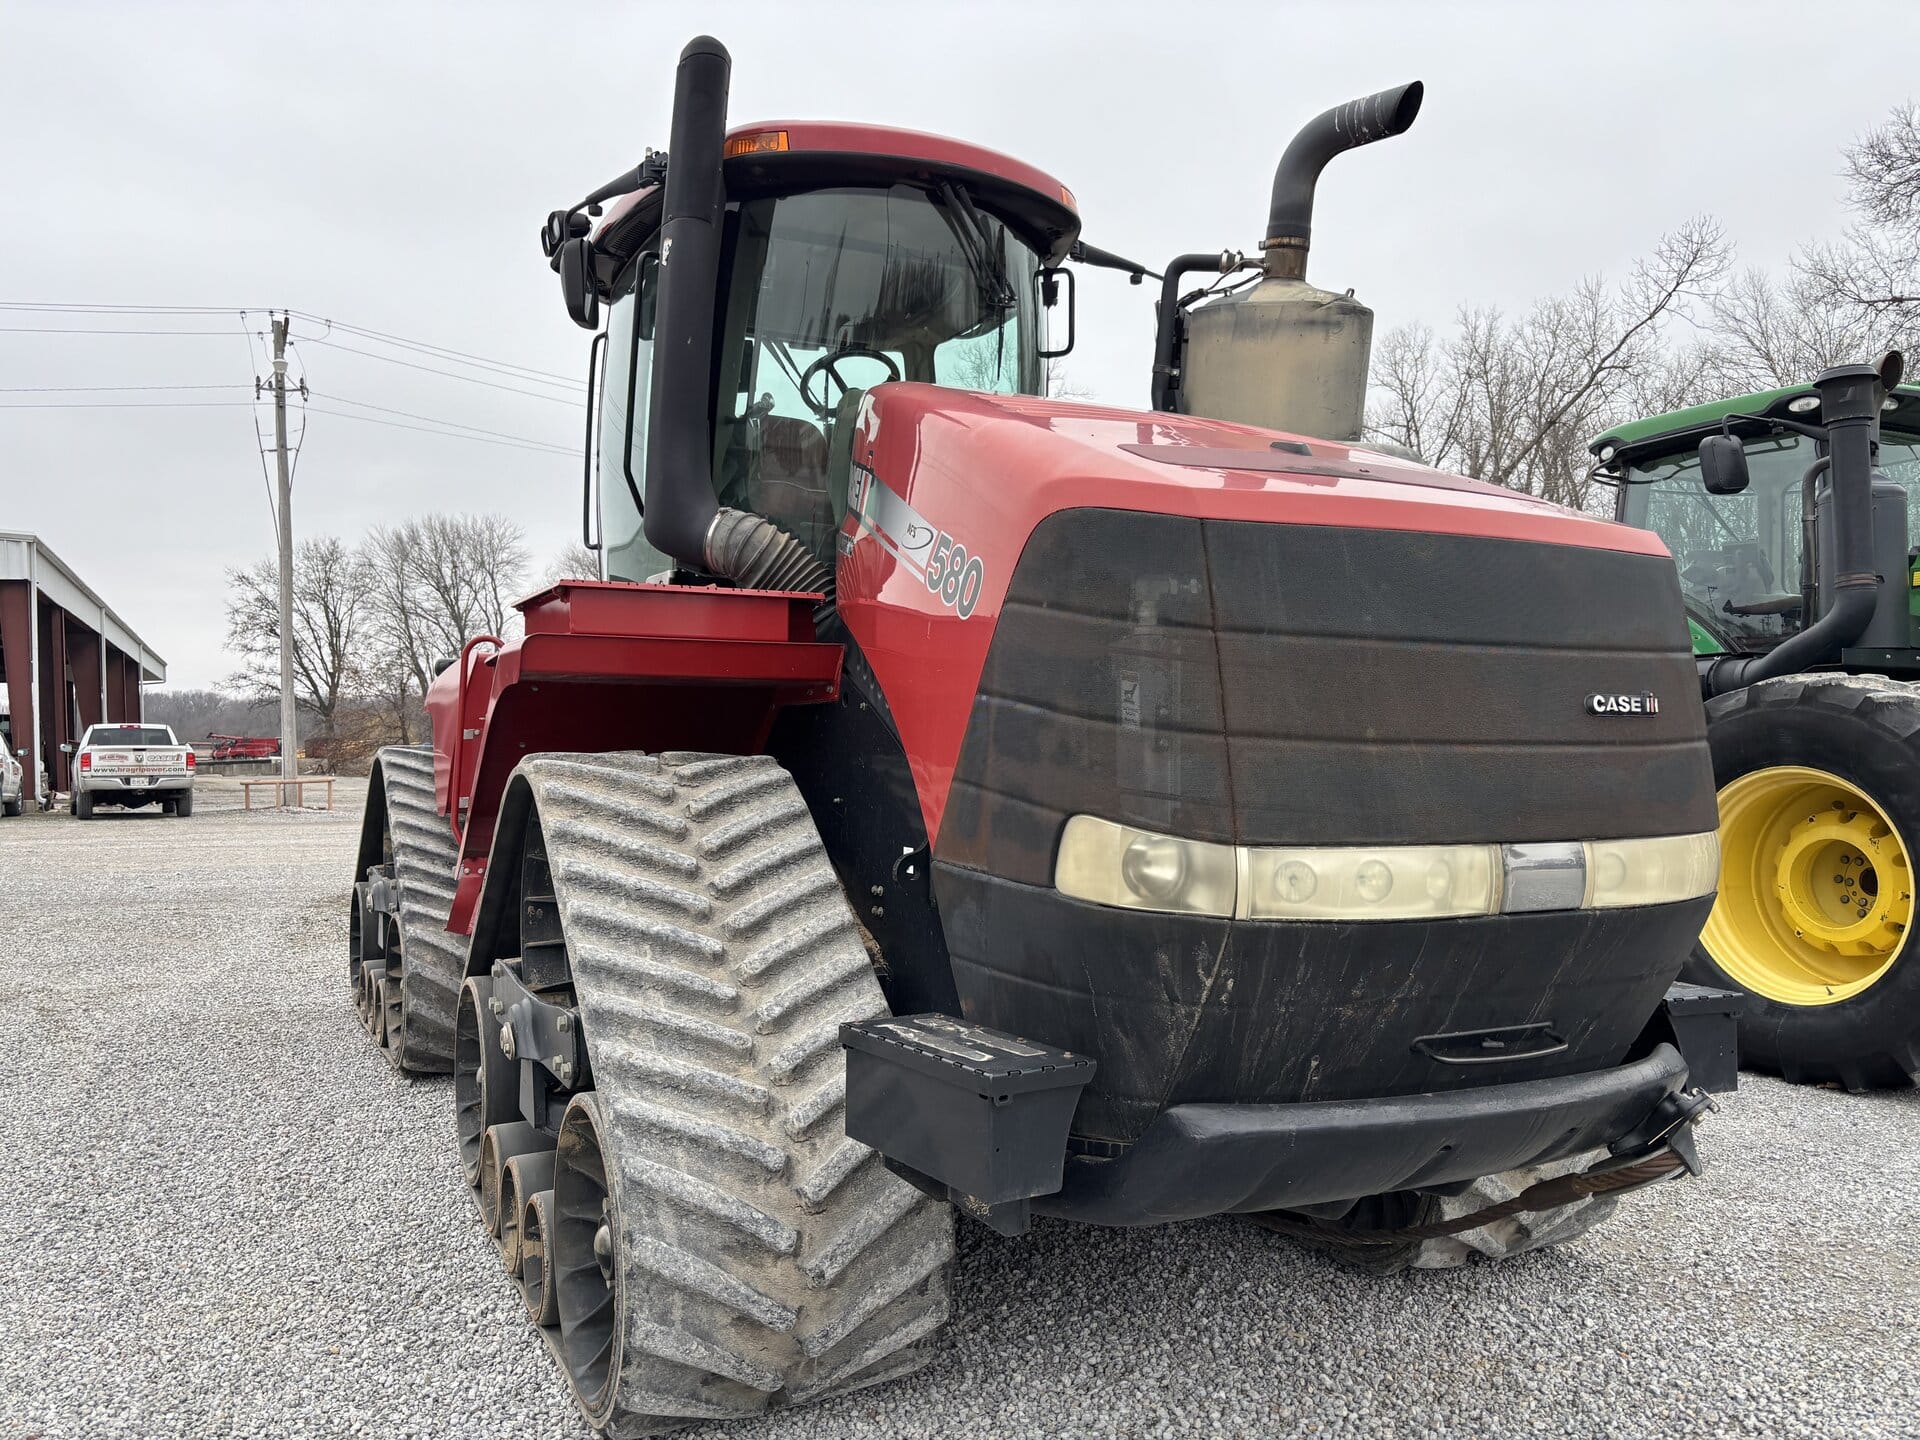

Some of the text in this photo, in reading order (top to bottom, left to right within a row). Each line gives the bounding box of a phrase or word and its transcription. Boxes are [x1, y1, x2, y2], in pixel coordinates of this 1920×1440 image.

[926, 530, 984, 620] 580
[1593, 695, 1642, 712] CASE
[93, 766, 185, 774] www.hragripower.com
